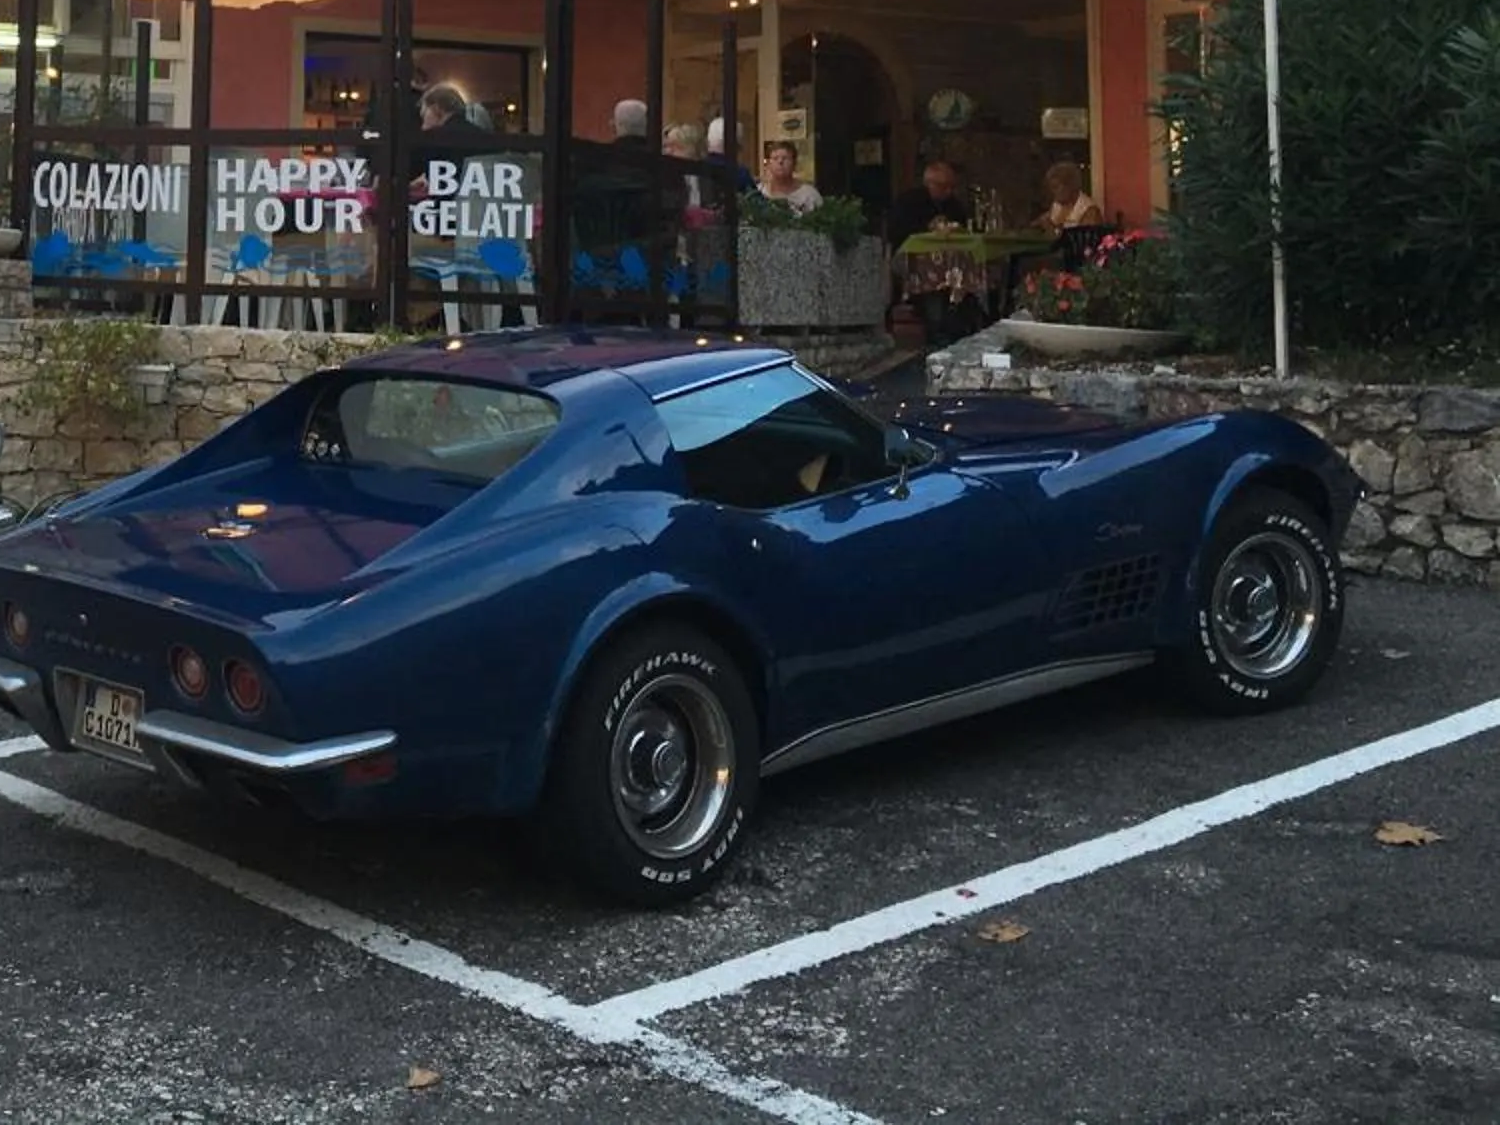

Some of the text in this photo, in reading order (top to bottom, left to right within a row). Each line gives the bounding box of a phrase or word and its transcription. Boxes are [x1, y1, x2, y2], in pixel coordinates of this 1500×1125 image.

[33, 161, 181, 213] COLAZIONI
[216, 158, 367, 194] HAPPY
[429, 160, 523, 199] BAR
[216, 197, 364, 233] HOUR
[411, 200, 534, 239] GELATI
[604, 652, 718, 731] FIREHAWK
